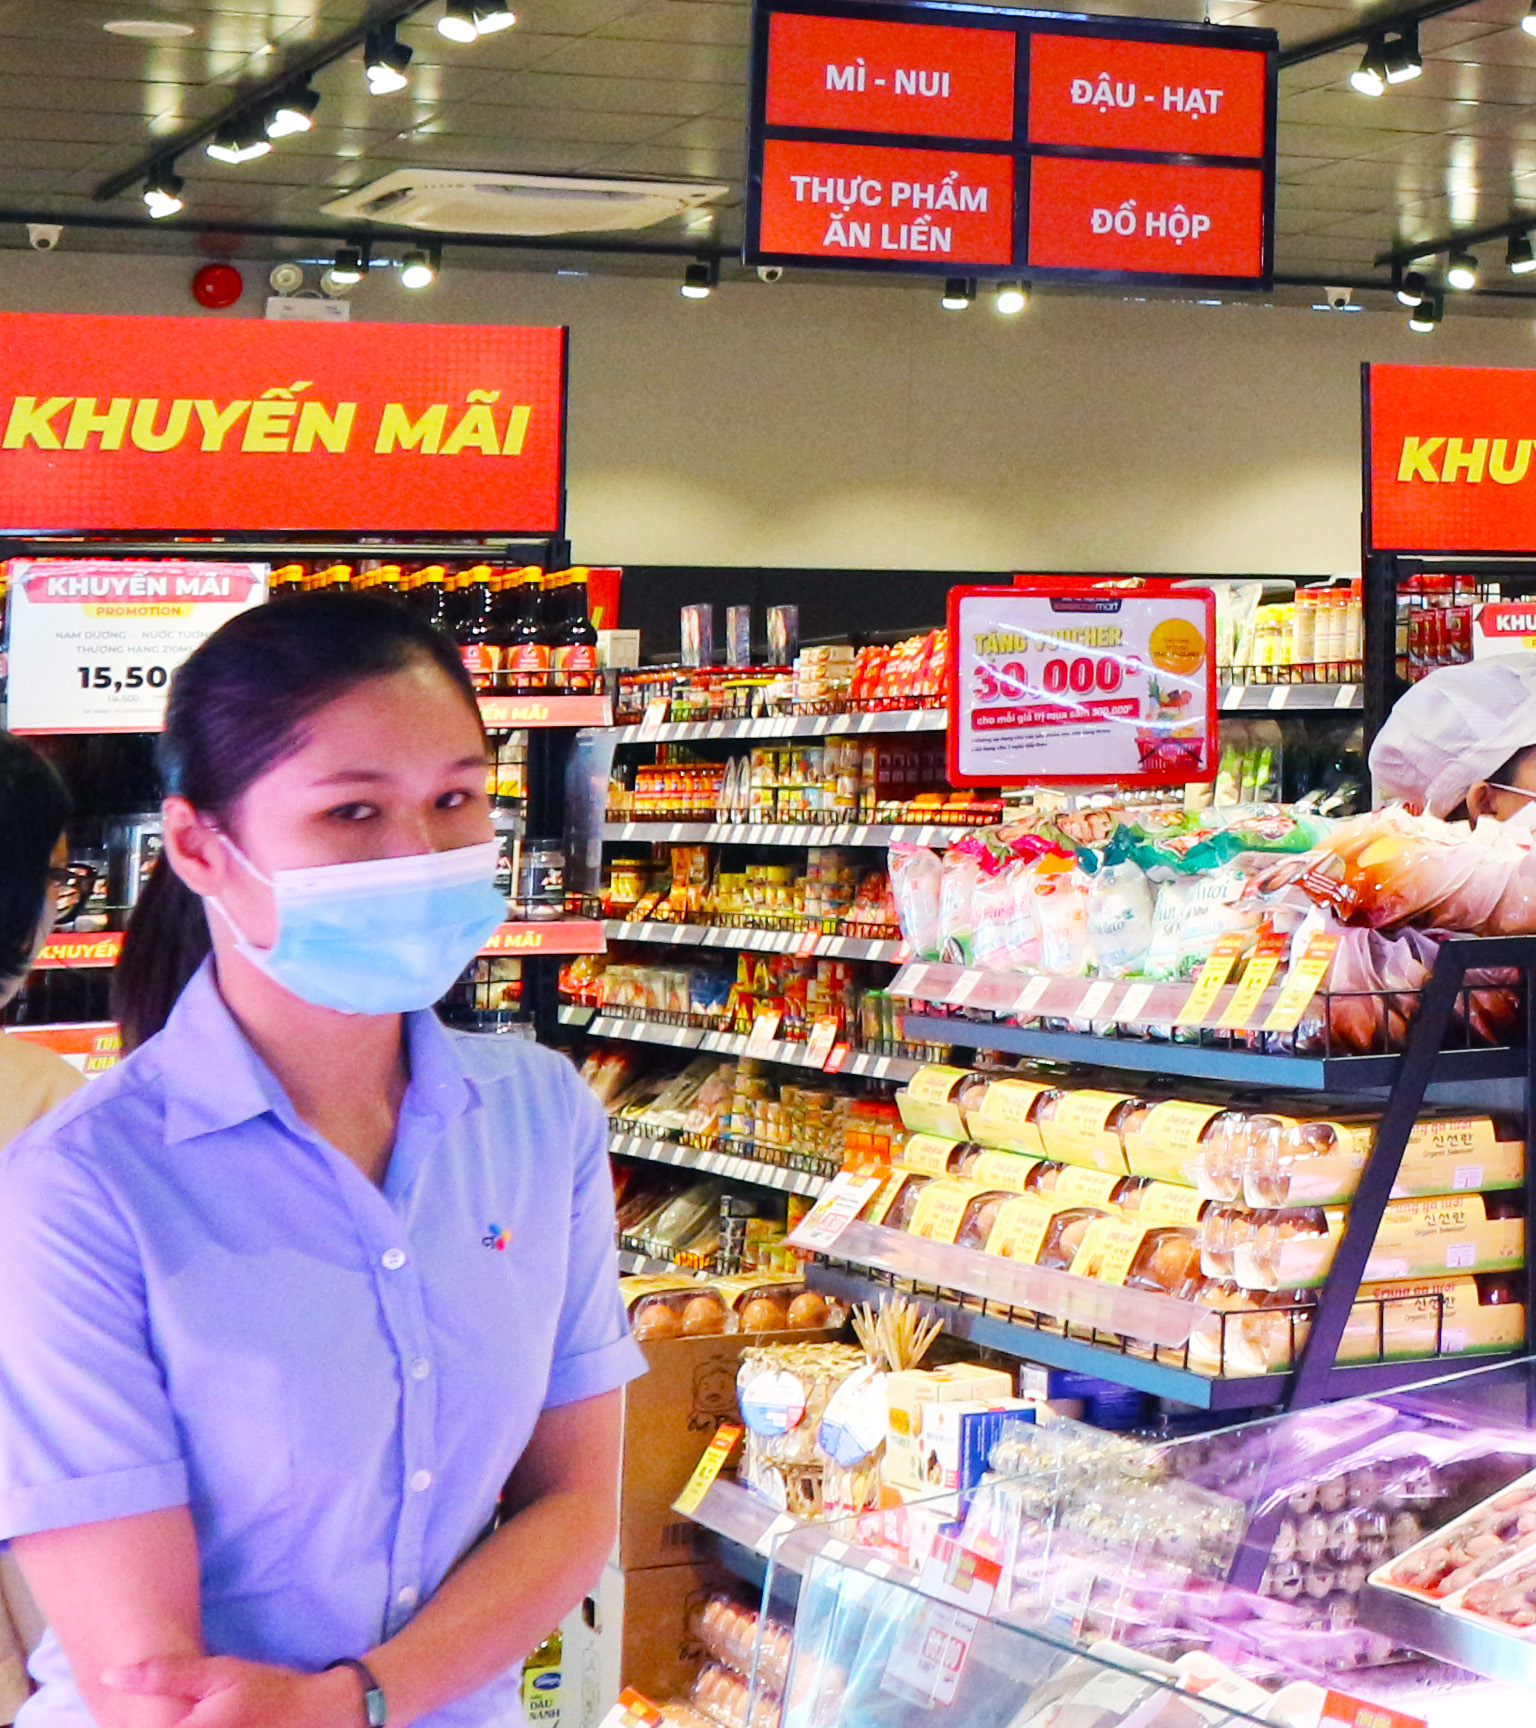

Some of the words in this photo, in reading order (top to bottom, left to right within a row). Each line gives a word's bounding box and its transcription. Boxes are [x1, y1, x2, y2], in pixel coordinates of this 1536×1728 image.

[825, 58, 866, 93] MÌ
[894, 69, 950, 98] NUI
[1070, 73, 1136, 113] ĐẬU
[1162, 86, 1223, 120] HẠT
[790, 174, 882, 211] THỰC
[892, 170, 988, 213] PHẨM
[823, 213, 871, 250] ĂN
[881, 214, 951, 253] LIỀN
[1091, 200, 1136, 235] ĐỒ
[1145, 204, 1210, 240] HỘP
[2, 380, 355, 454] KHUYẾN
[374, 389, 532, 456] MÃI
[176, 571, 230, 597] MÃI
[96, 606, 181, 617] PROMOTION
[78, 667, 168, 693] 15,50
[504, 930, 542, 947] MÃI
